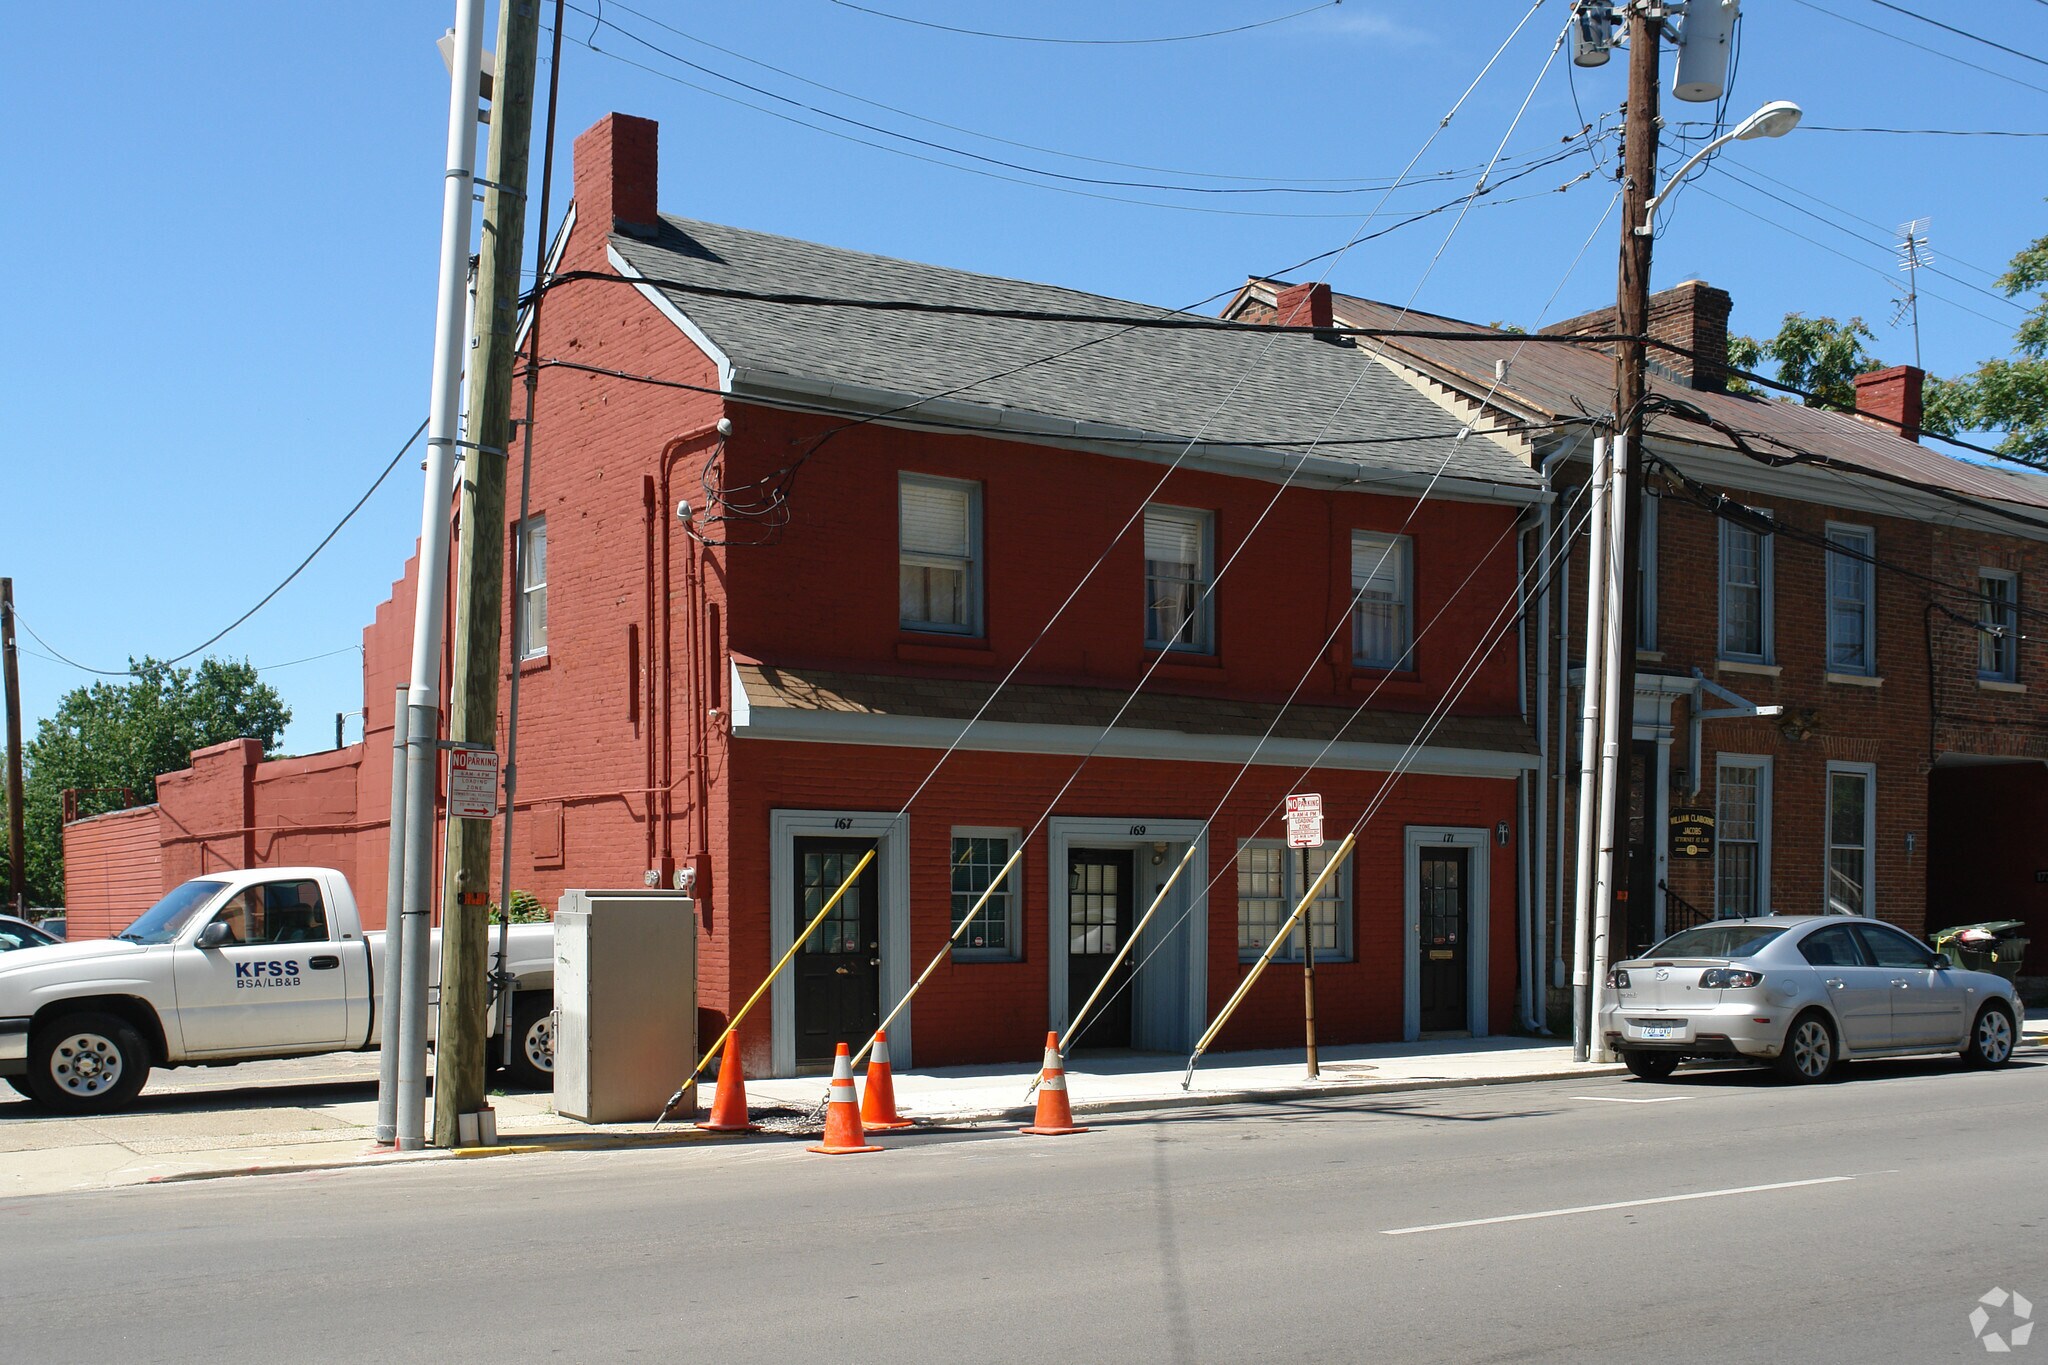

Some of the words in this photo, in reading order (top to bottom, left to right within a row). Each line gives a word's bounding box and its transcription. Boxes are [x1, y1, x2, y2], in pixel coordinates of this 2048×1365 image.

[453, 754, 466, 766] NO
[468, 756, 496, 767] PARKING
[1288, 799, 1298, 810] NO
[1298, 800, 1318, 808] PARKING
[834, 818, 853, 830] 167
[1670, 814, 1690, 825] WILLIAM
[1690, 814, 1715, 827] CLAIBORNE
[1129, 825, 1146, 836] 169
[1682, 827, 1702, 835] JACOBS
[1443, 833, 1455, 843] 171
[235, 960, 300, 978] KFSS
[236, 977, 301, 989] BSA/LB&B
